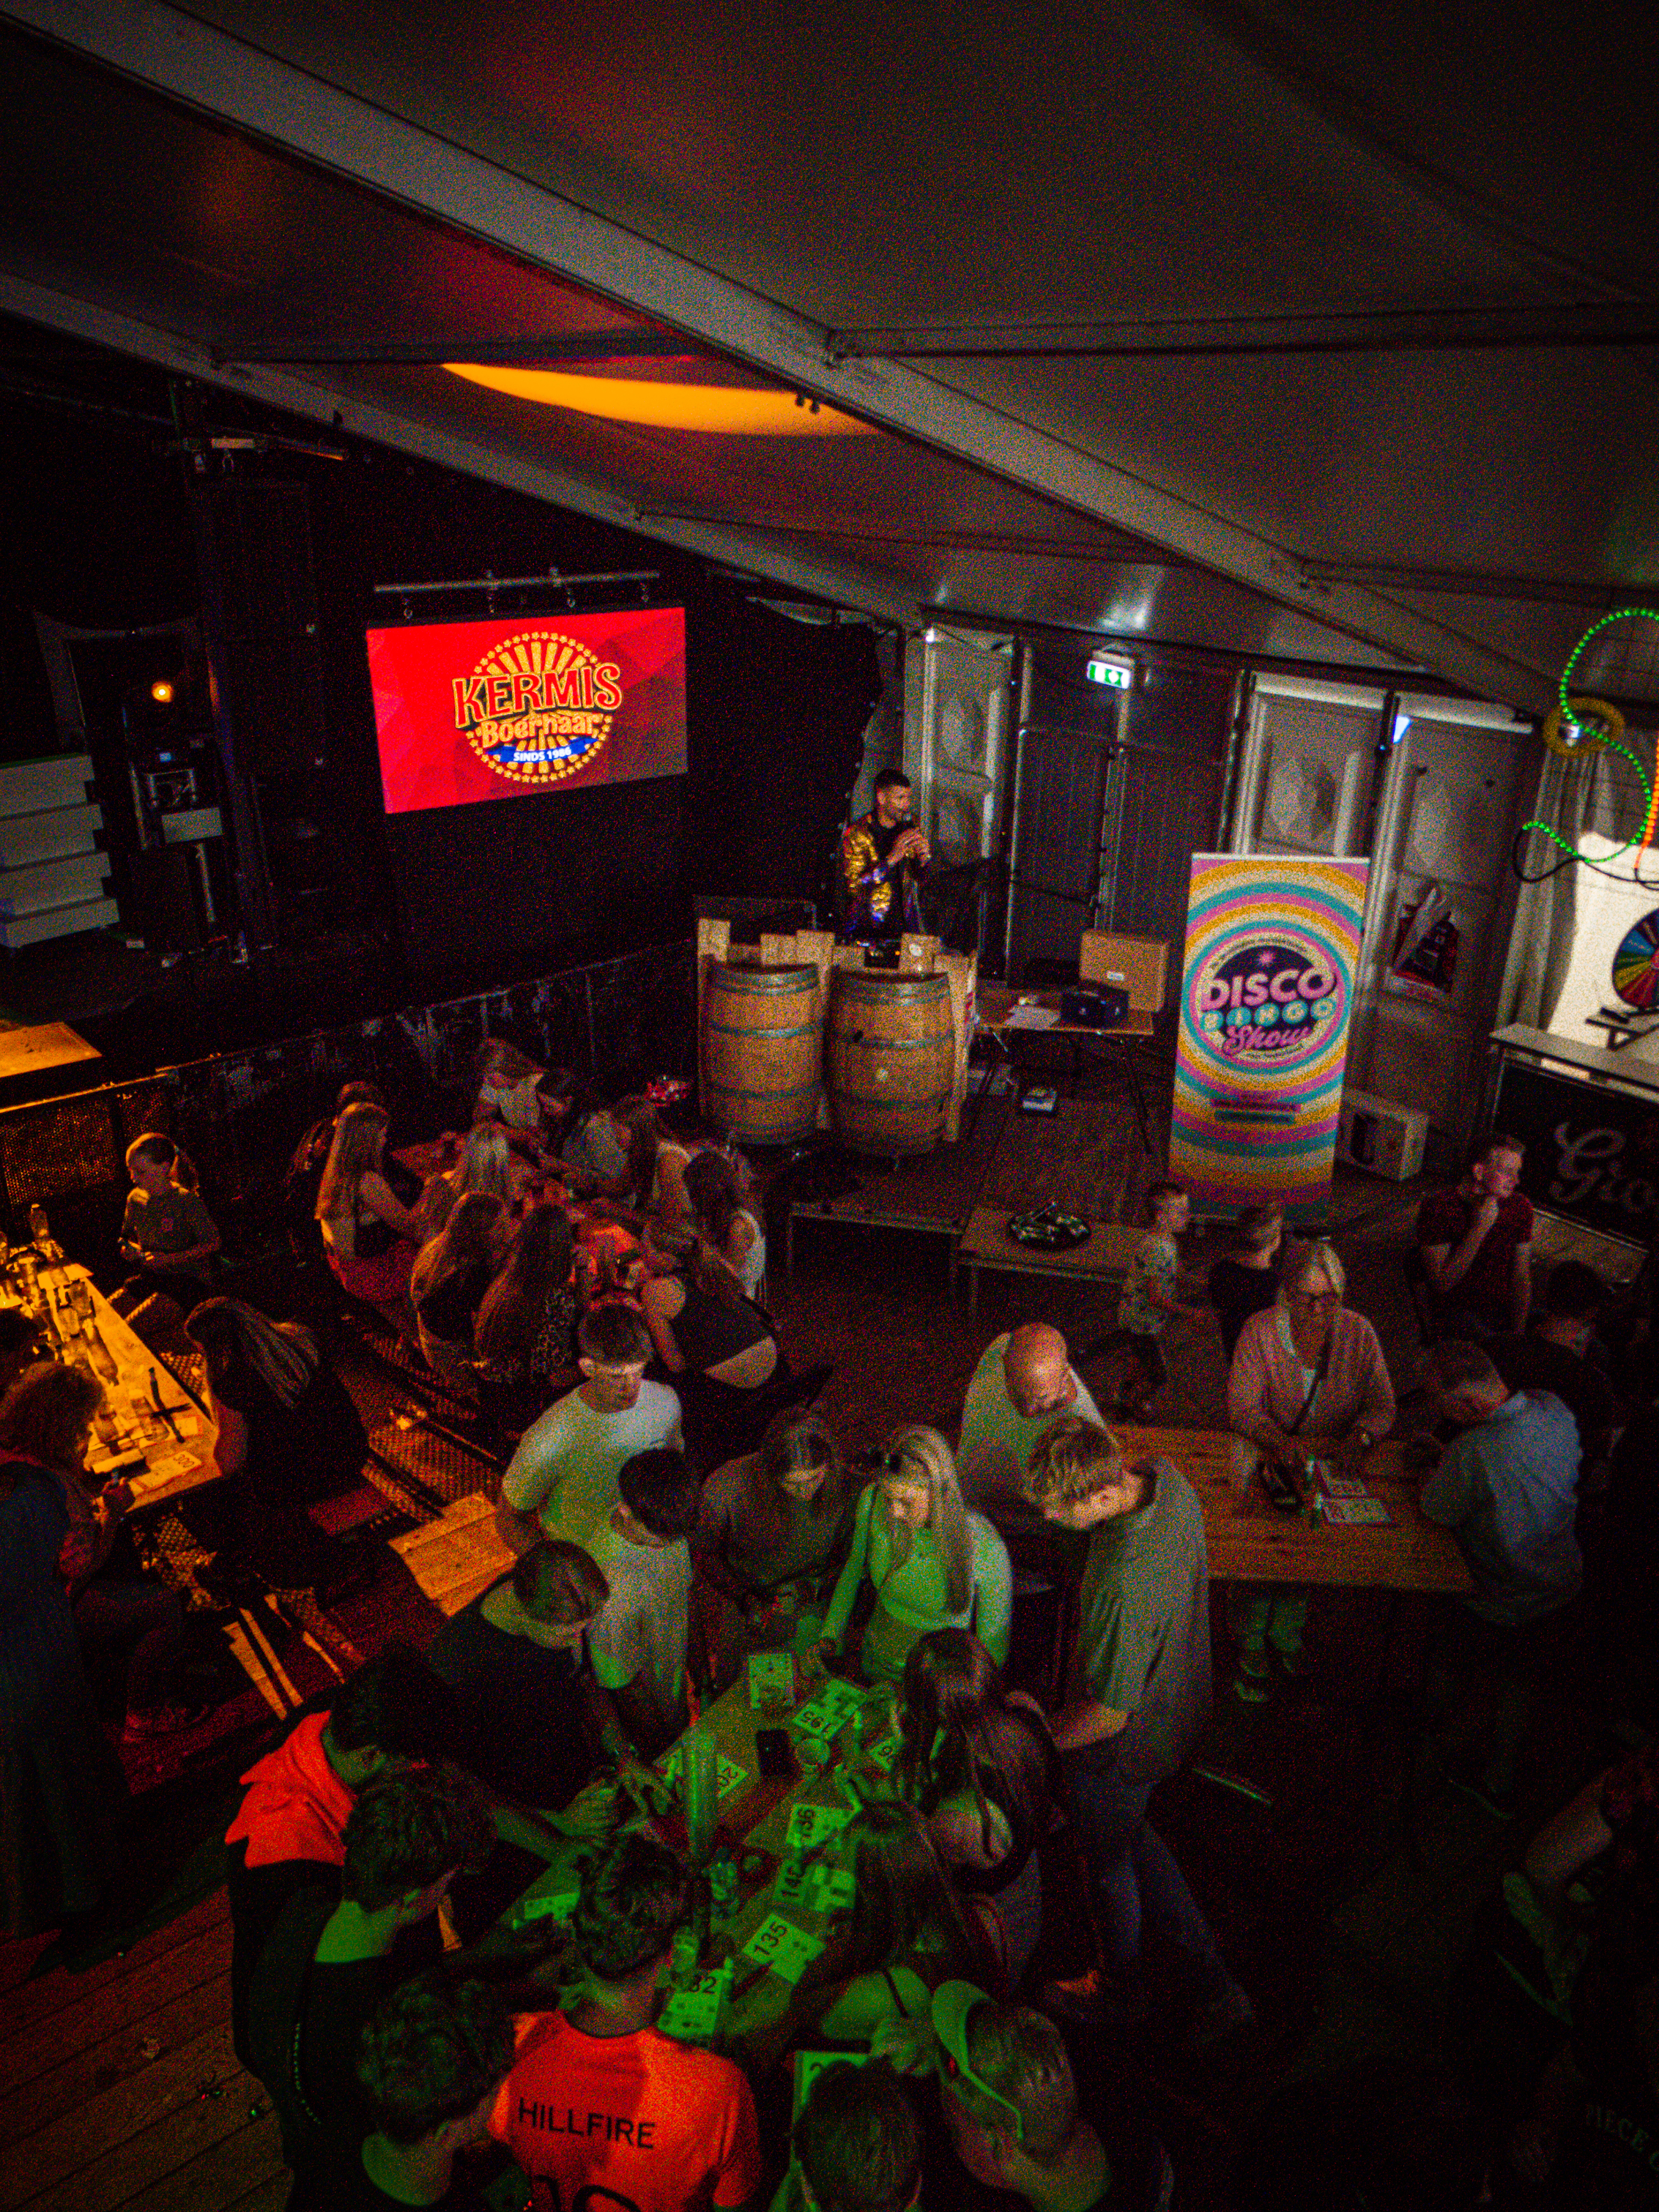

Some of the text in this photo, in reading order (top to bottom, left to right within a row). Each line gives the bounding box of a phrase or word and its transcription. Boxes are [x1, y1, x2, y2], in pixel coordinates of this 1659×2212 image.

[452, 662, 623, 729] KERMIS
[480, 711, 604, 749] Boerhaar
[513, 751, 546, 762] SINDS
[1200, 965, 1337, 1012] DISCO
[1201, 998, 1335, 1032] BINGO
[1222, 1023, 1313, 1056] Show
[752, 1922, 788, 1956] 135
[518, 2097, 656, 2149] HILLFIRE
